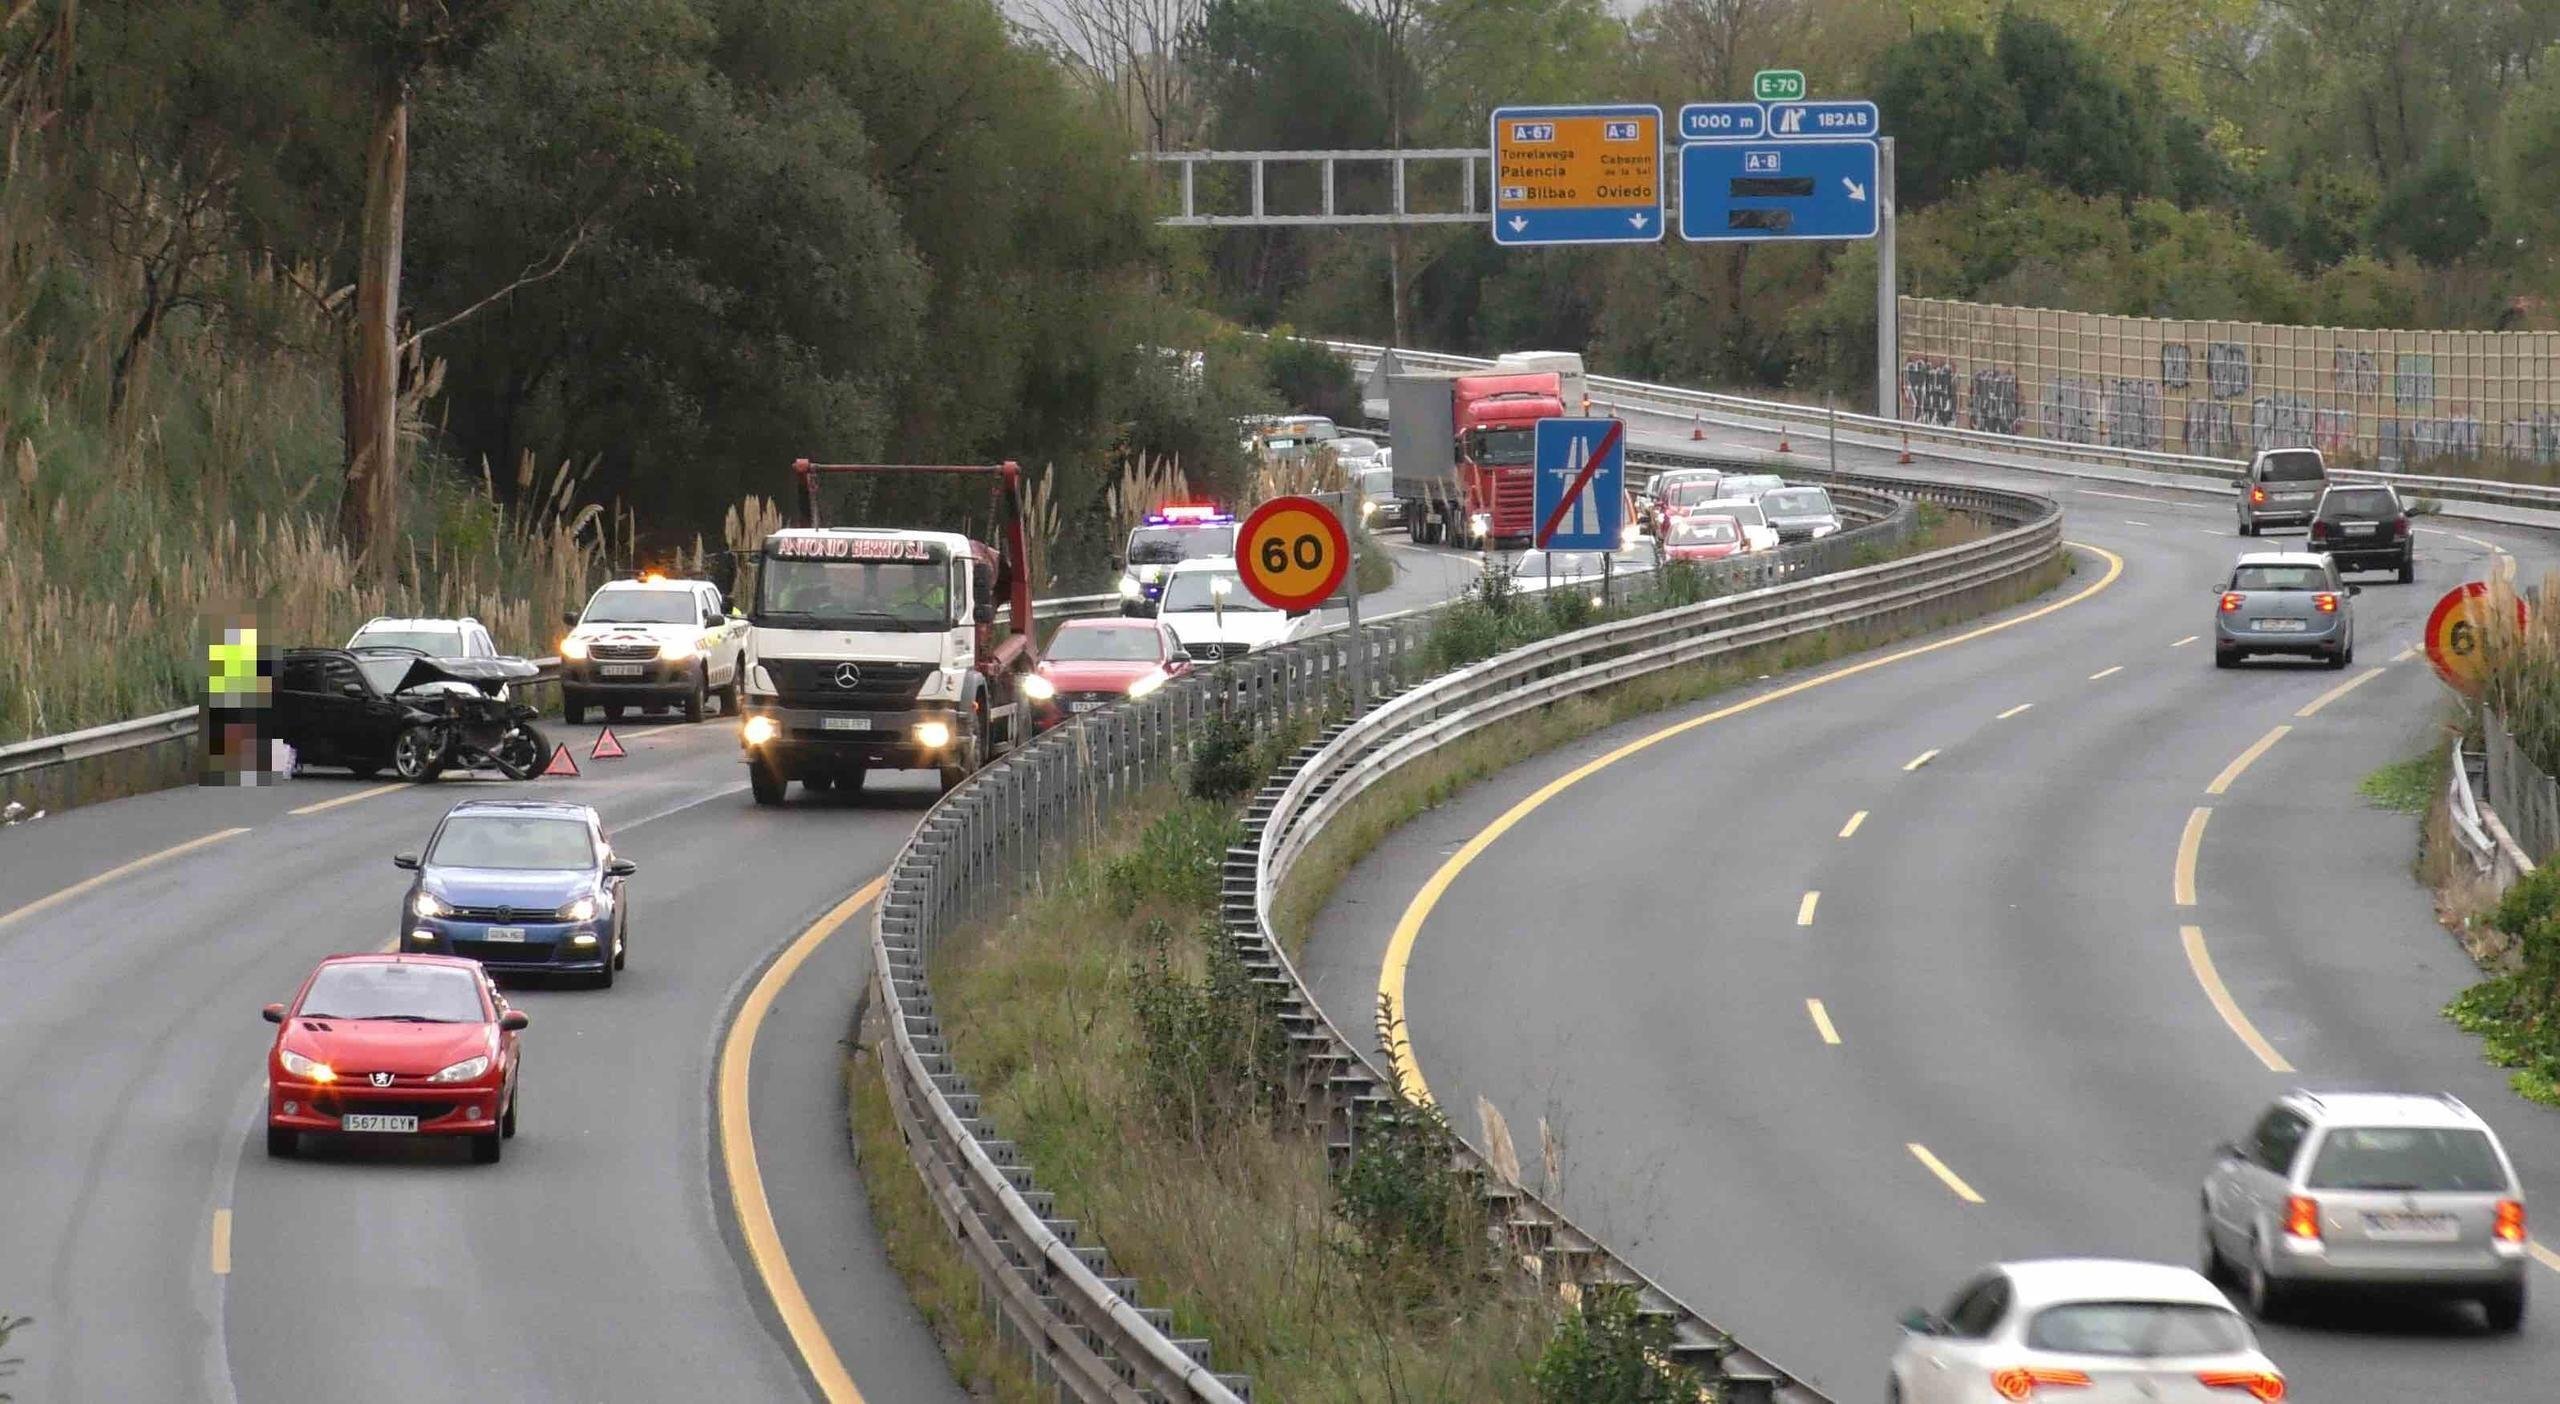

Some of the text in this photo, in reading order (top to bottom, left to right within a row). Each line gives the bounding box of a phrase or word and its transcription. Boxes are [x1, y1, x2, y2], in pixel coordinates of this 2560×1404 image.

[1761, 79, 1798, 92] E-70
[1690, 114, 1754, 128] 1000 m
[1818, 112, 1867, 127] 182AB
[1516, 125, 1552, 139] A-67
[1608, 124, 1636, 137] A-8
[1501, 149, 1574, 161] Torrelavega
[1750, 155, 1778, 168] A-8
[1501, 166, 1566, 177] Palencia
[1527, 187, 1576, 199] Bilbao
[1597, 185, 1652, 198] Oviedo
[778, 537, 848, 557] ANTONIO
[1262, 534, 1323, 573] 60
[351, 1116, 386, 1129] 5671
